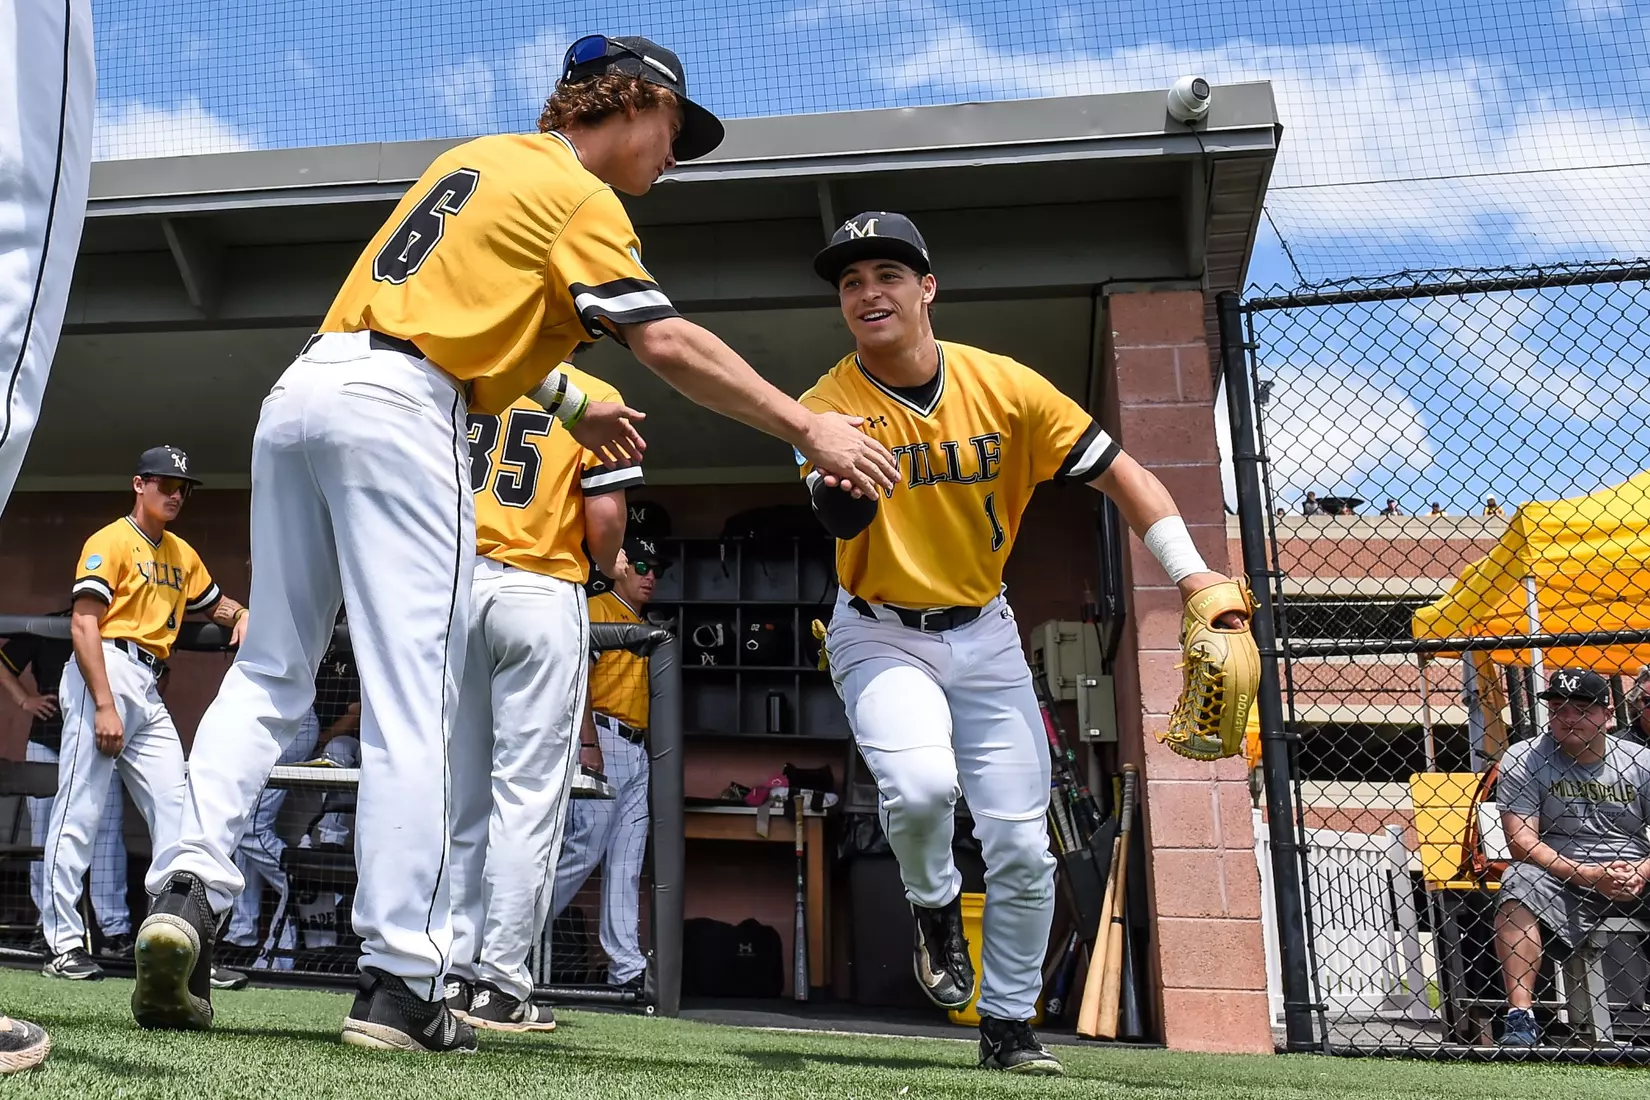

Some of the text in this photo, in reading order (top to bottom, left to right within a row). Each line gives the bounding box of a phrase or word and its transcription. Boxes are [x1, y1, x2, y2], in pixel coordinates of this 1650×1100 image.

[372, 167, 480, 285] 6
[844, 218, 879, 240] M
[171, 452, 188, 474] M
[984, 491, 1005, 552] 1
[1197, 587, 1242, 609] Won
[1558, 673, 1580, 692] M
